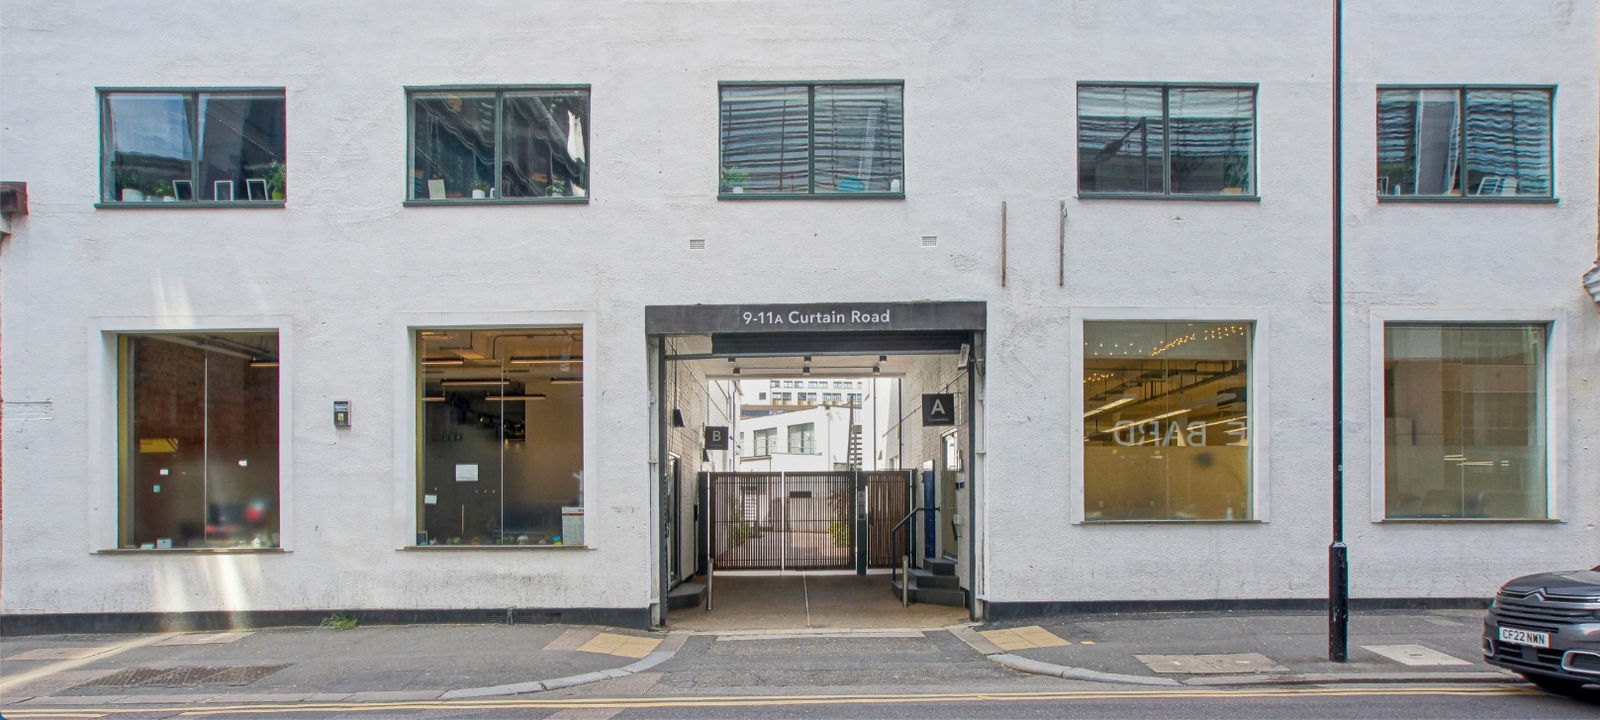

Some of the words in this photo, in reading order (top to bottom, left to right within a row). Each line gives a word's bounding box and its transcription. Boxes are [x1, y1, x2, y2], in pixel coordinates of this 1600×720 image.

[743, 311, 783, 325] 9-11A
[788, 310, 845, 324] Curtain
[851, 309, 890, 323] Road
[931, 399, 946, 415] A
[712, 430, 721, 442] B
[1503, 629, 1525, 641] CF22
